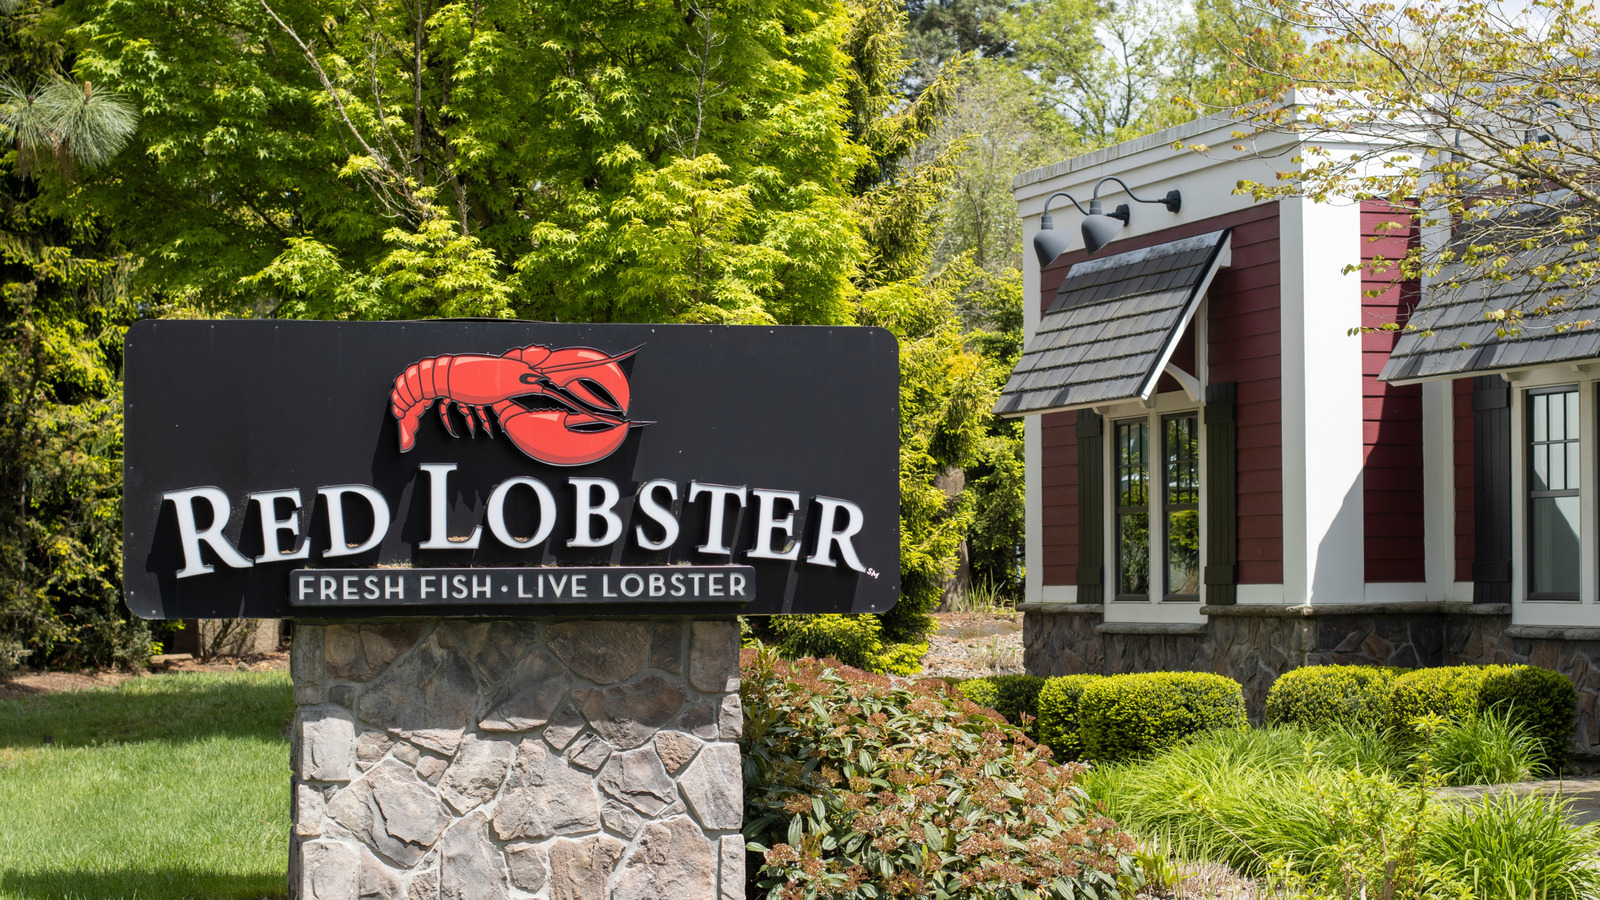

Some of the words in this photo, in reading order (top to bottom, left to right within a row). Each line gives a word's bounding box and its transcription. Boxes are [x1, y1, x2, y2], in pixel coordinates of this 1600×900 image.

[162, 485, 391, 579] RED
[418, 462, 867, 573] LOBSTER
[299, 575, 405, 600] FRESH
[420, 574, 492, 599] FISH
[517, 574, 588, 598] LIVE
[602, 572, 747, 598] LOBSTER
[866, 567, 880, 579] SM
